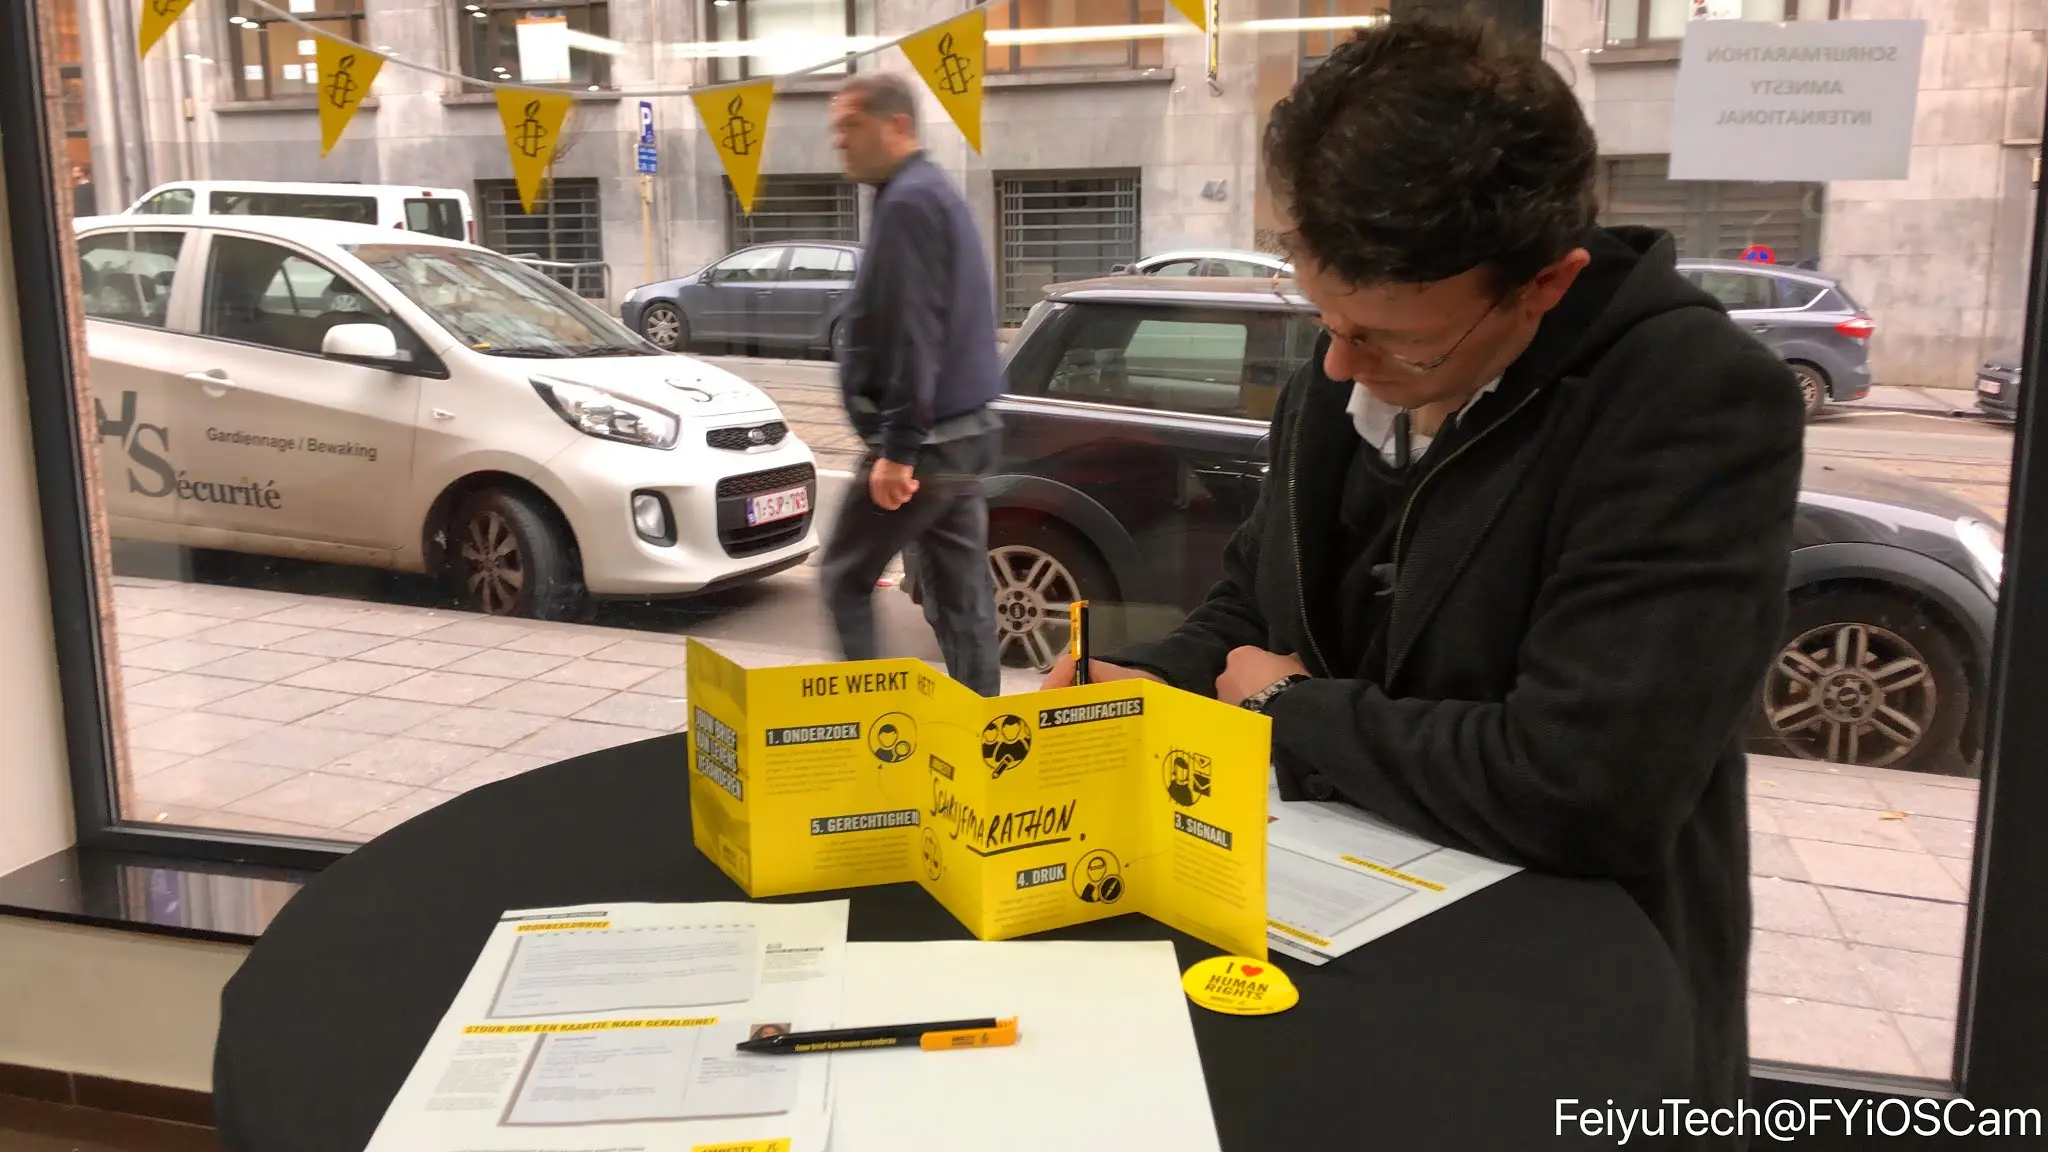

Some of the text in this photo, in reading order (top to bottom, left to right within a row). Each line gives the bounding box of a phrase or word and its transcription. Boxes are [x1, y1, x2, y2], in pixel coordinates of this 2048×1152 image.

[641, 106, 652, 136] P
[1201, 179, 1227, 201] 46
[206, 427, 296, 451] Gardiennage
[307, 438, 378, 462] Bewaking
[802, 676, 839, 697] HOE
[846, 672, 908, 694] WERKT
[1040, 713, 1051, 727] 2.
[767, 724, 858, 744] 1. ONDERZOEK
[811, 820, 824, 834] 5.
[1175, 814, 1228, 847] 3. SIGNAAL
[1017, 865, 1064, 886] 4. DRUK
[1225, 962, 1235, 975] I
[1203, 983, 1264, 1001] RIGHTS
[1208, 974, 1270, 994] HUMAN
